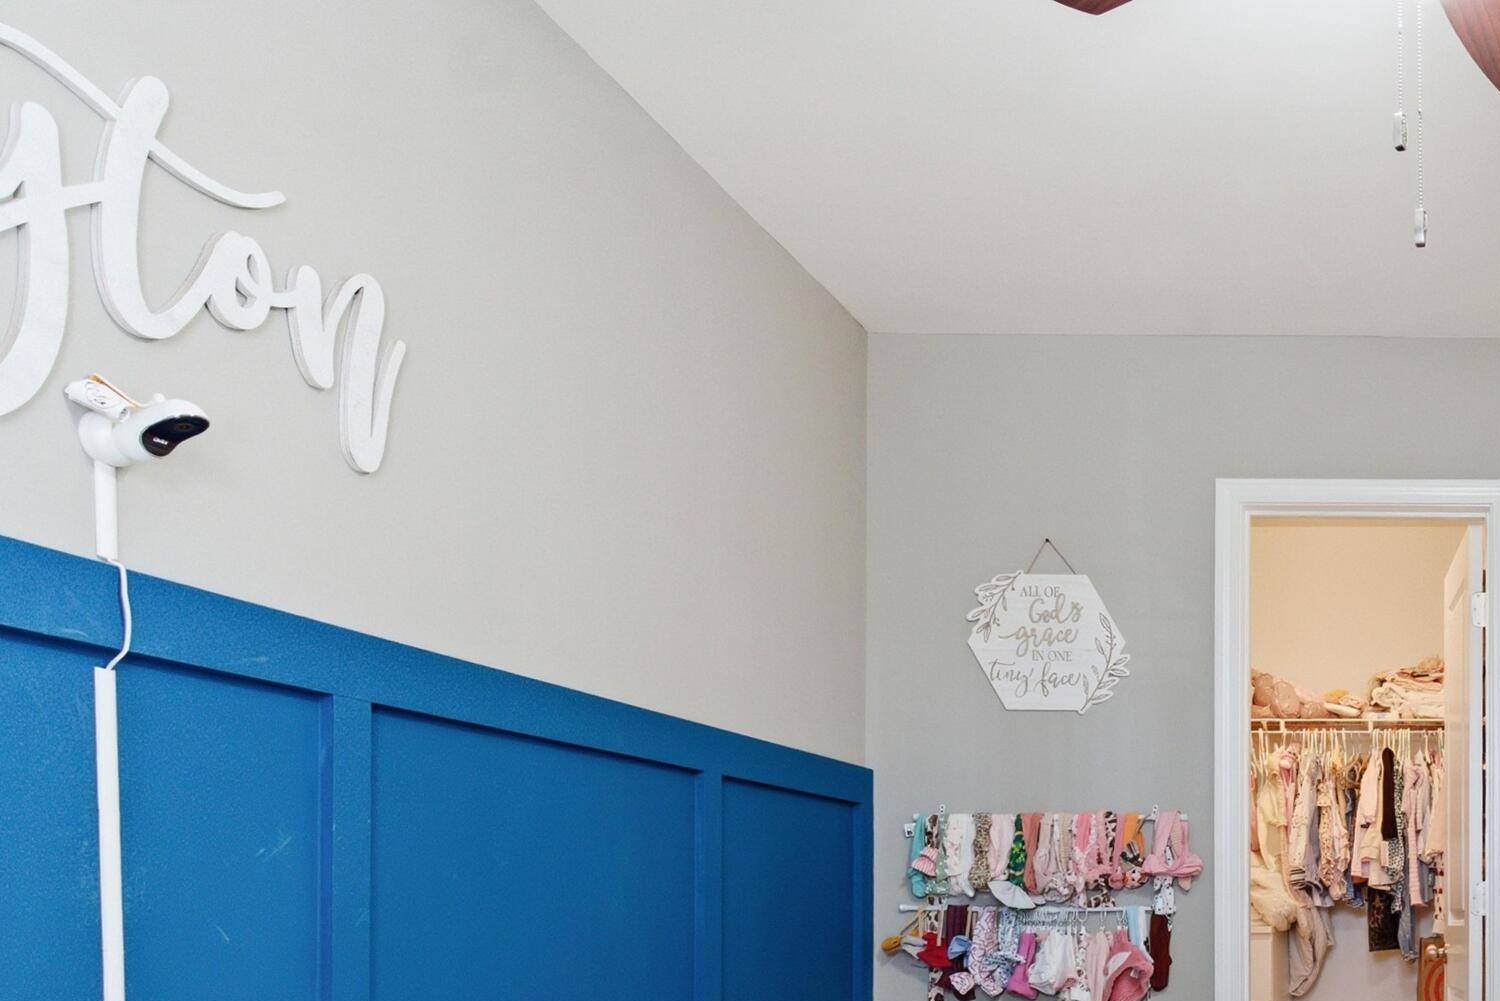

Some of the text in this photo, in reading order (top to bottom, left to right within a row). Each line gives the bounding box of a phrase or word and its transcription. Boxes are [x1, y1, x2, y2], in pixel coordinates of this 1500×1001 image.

[1020, 585, 1060, 597] ALL OF
[998, 626, 1079, 657] grace
[1032, 649, 1072, 662] IN ONE
[988, 658, 1081, 698] tiny face
